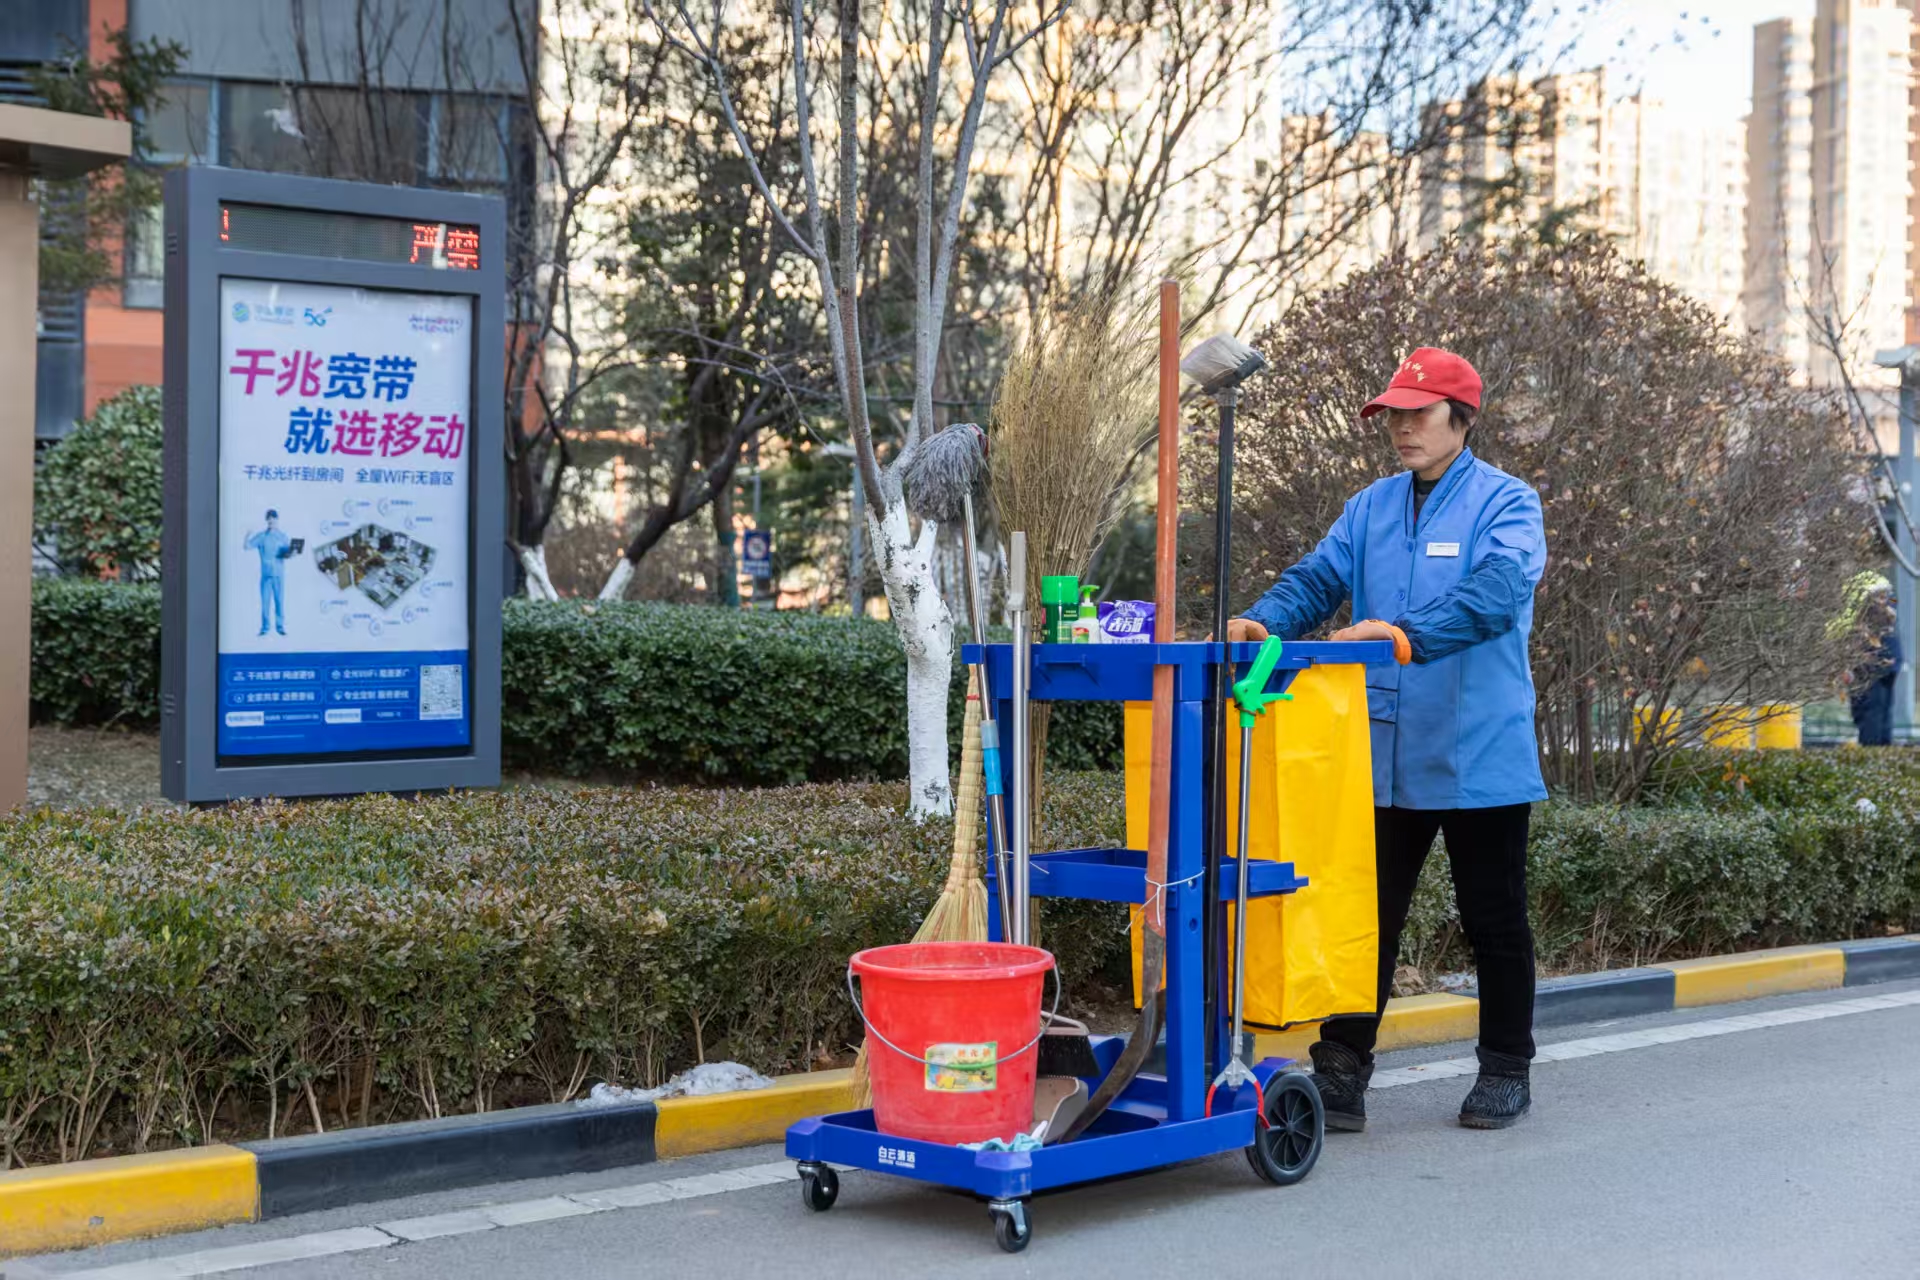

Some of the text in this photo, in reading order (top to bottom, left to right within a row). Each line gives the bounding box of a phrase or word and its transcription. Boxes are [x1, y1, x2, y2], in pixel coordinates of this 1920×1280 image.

[229, 349, 417, 402] 千兆宽带
[284, 406, 465, 459] 就选移动
[243, 464, 345, 483] 千兆光纤到房间
